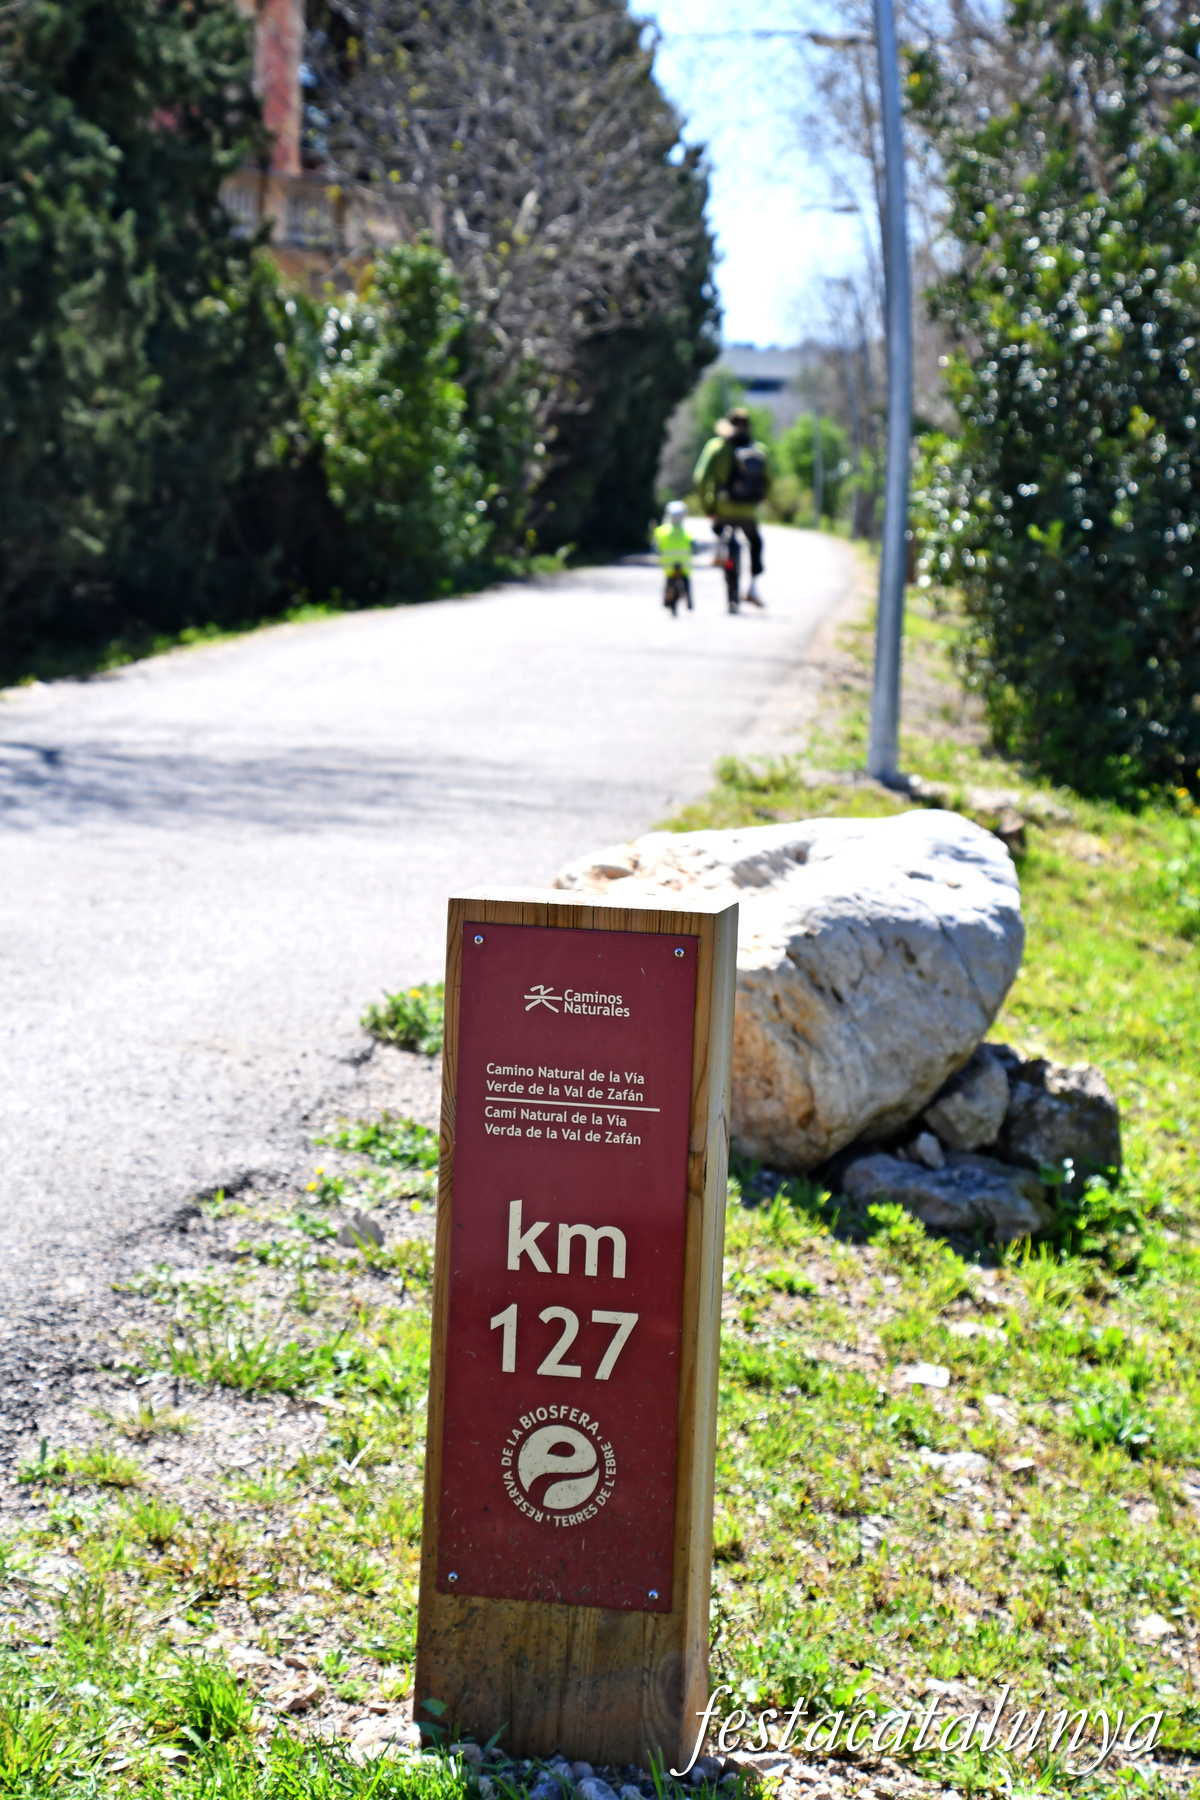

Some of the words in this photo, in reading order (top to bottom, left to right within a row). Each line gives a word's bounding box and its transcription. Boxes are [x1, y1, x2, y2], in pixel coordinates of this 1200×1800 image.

[564, 989, 623, 1005] Caminos
[563, 1001, 630, 1017] Naturales
[486, 1063, 534, 1077] Camino
[538, 1066, 585, 1081] Natural
[589, 1069, 605, 1082] de
[609, 1071, 620, 1083] la
[624, 1072, 645, 1085] Vía
[486, 1080, 524, 1094] Verde
[528, 1083, 544, 1095] de
[548, 1084, 560, 1096] la
[564, 1085, 583, 1098] Val
[587, 1087, 603, 1099] de
[607, 1088, 644, 1102] Zafán
[484, 1106, 516, 1119] Camí
[520, 1108, 567, 1123] Natural
[571, 1112, 587, 1124] de
[591, 1113, 603, 1125] la
[606, 1114, 627, 1127] Via
[484, 1123, 522, 1137] Verda
[526, 1126, 542, 1138] de
[546, 1127, 557, 1139] la
[561, 1128, 581, 1141] Val
[584, 1130, 601, 1142] de
[604, 1131, 641, 1145] Zafán
[507, 1199, 627, 1279] km
[490, 1303, 639, 1381] 127
[519, 1405, 599, 1436] BIOSFERA
[506, 1428, 524, 1446] LA
[501, 1447, 514, 1467] DE
[600, 1441, 617, 1487] L'EBRE
[502, 1470, 544, 1523] RESERVA
[595, 1488, 612, 1506] DE
[553, 1504, 598, 1527] TERRES
